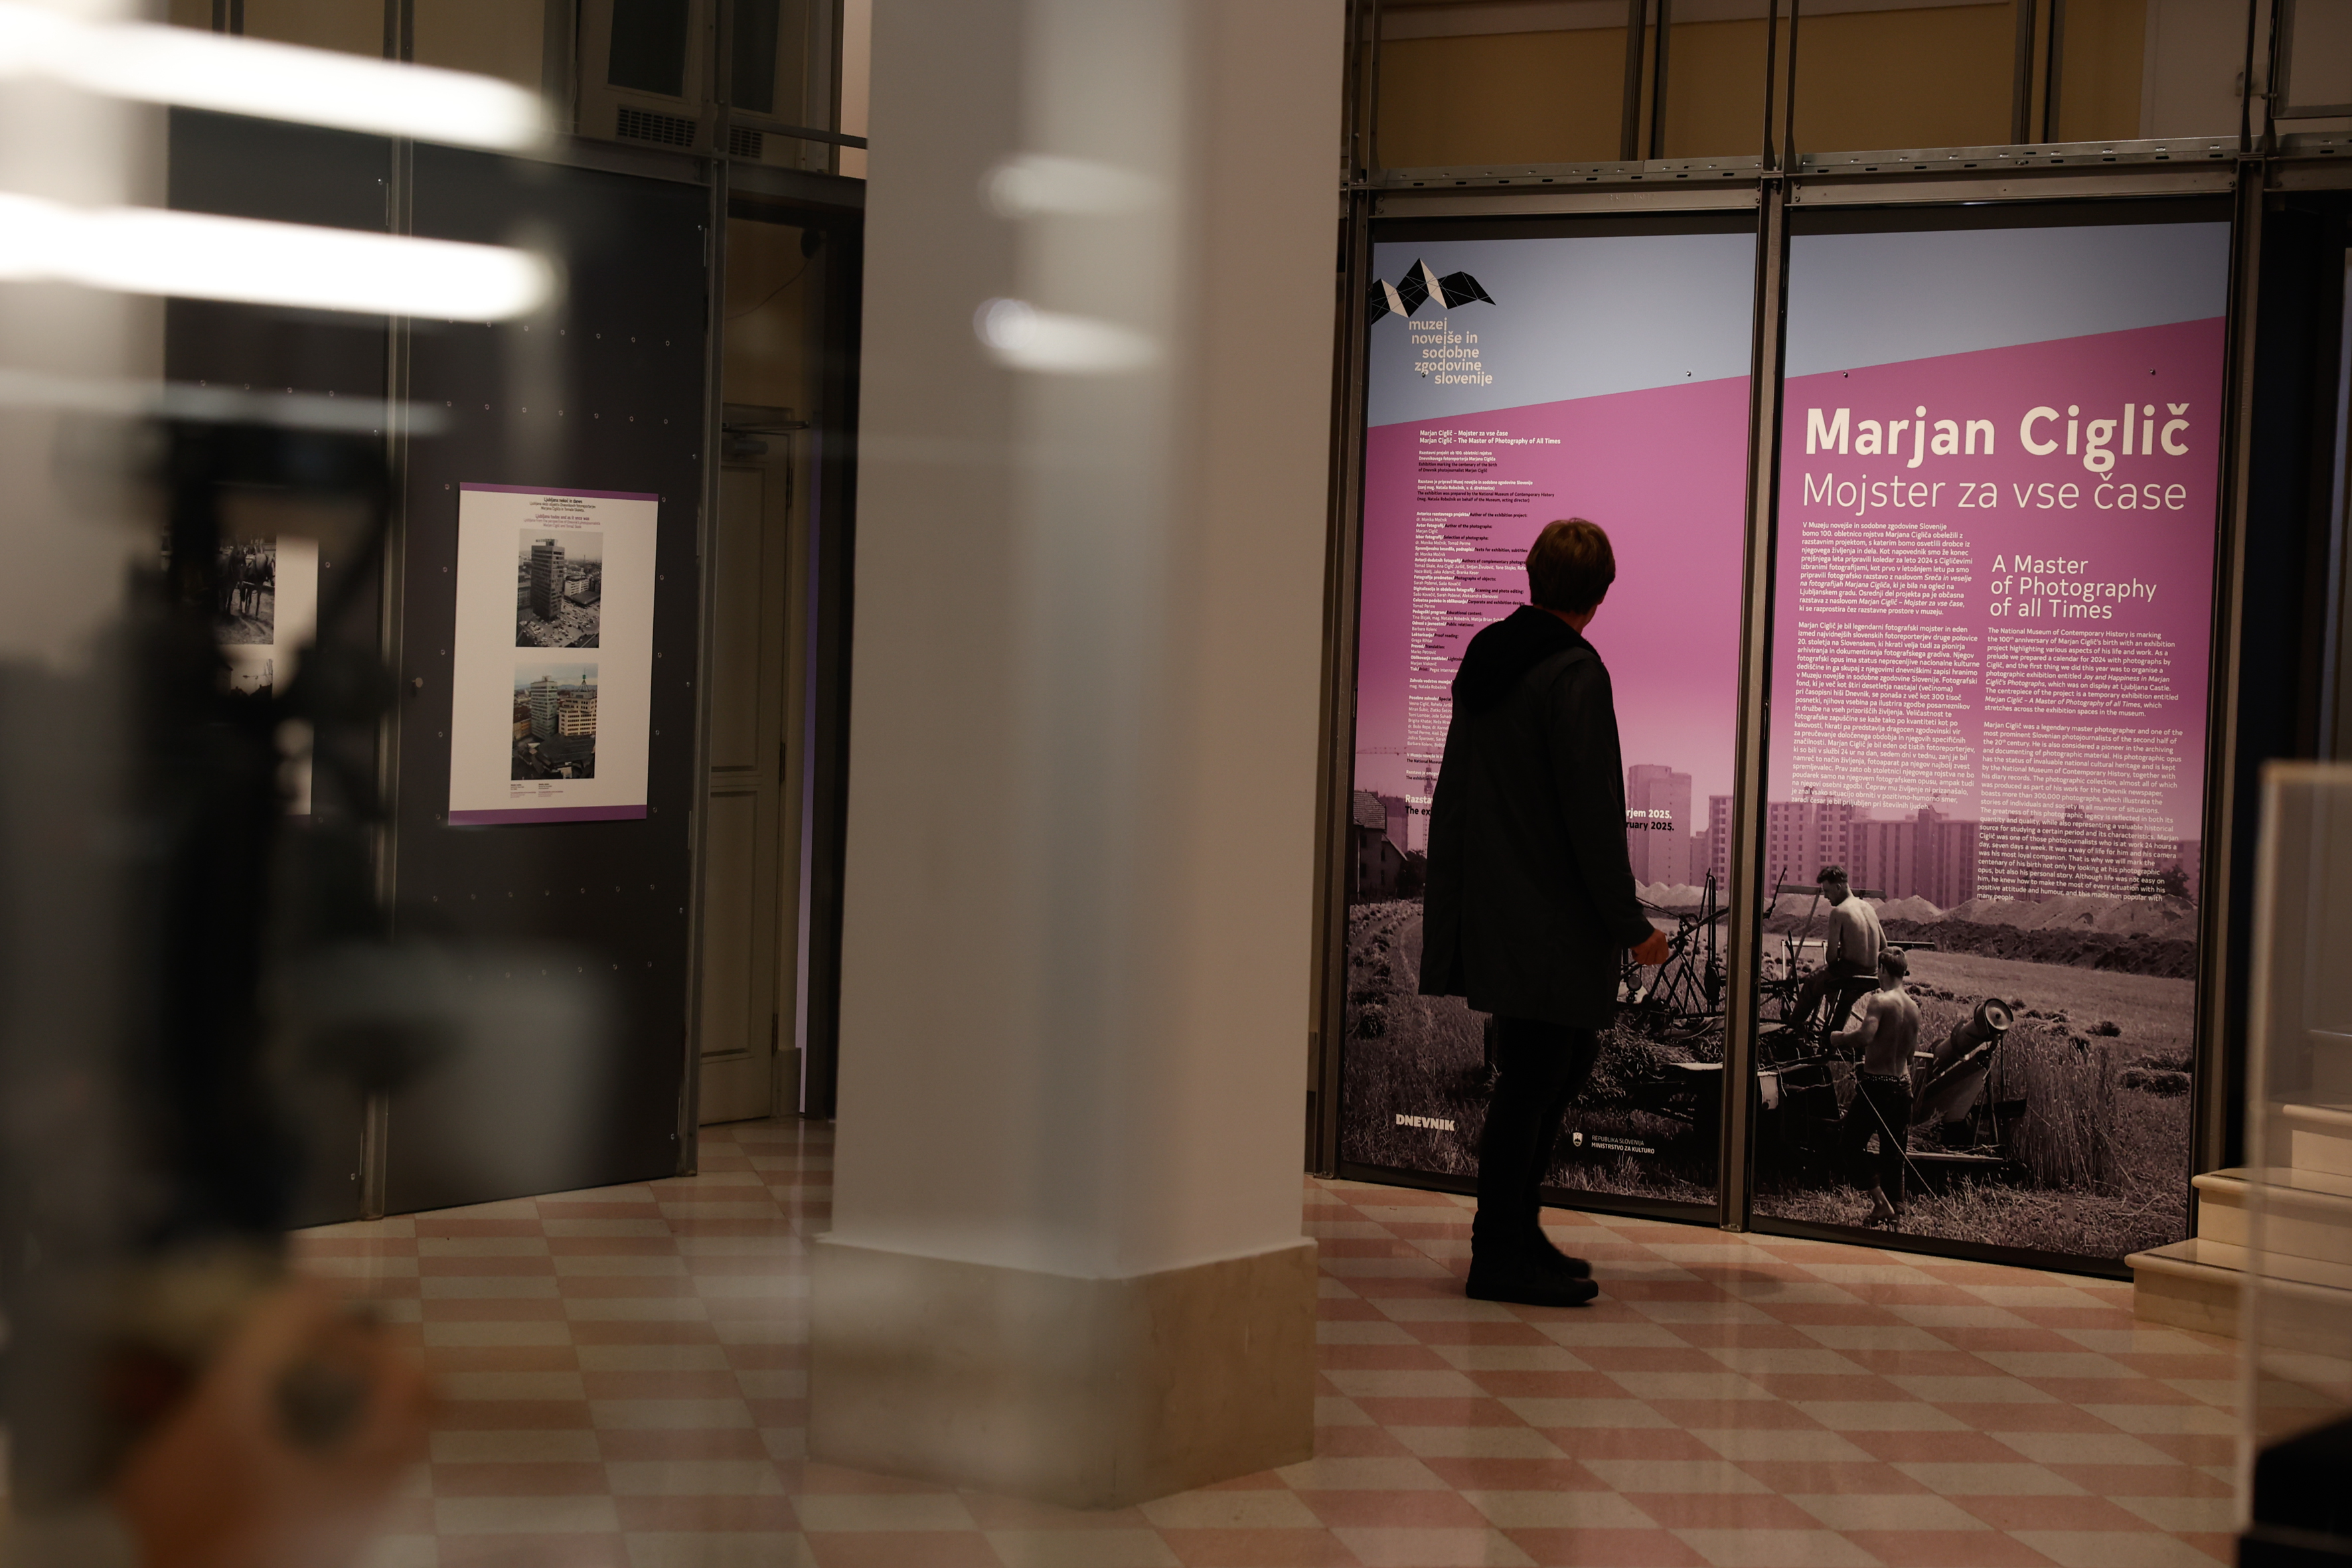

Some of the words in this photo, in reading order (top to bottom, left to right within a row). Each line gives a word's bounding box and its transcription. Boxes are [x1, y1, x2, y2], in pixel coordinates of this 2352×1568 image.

[1409, 317, 1447, 331] muzej
[1411, 331, 1462, 345] novejše
[1466, 331, 1478, 344] in
[1422, 345, 1479, 358] sodobne
[1415, 358, 1482, 375] zgodovine
[1435, 371, 1492, 386] slovenije
[1806, 405, 1994, 468] Marjan
[2019, 403, 2189, 472] Ciglič
[1804, 473, 1946, 516] Mojster
[1958, 483, 1997, 509] za
[2013, 483, 2079, 509] vse
[2094, 473, 2186, 510] čase
[1992, 555, 2005, 572] A
[2014, 555, 2088, 574] Master
[1991, 576, 2013, 594] of
[2019, 578, 2157, 601] Photography
[1990, 597, 2012, 616] of
[2018, 597, 2041, 617] all
[2049, 599, 2112, 619] Times
[1852, 623, 1883, 631] legendarni
[2061, 629, 2104, 637] Contemporary
[2041, 724, 2070, 732] legendary
[2094, 726, 2136, 735] photographer
[1405, 794, 1433, 803] Razsta
[1843, 799, 1871, 807] priljubljen
[1909, 802, 1929, 811] ljudeh.
[1405, 806, 1419, 815] The
[1648, 809, 1672, 819] 2025.
[1651, 822, 1674, 830] 2025.
[1395, 1114, 1454, 1131] DNEVNIK
